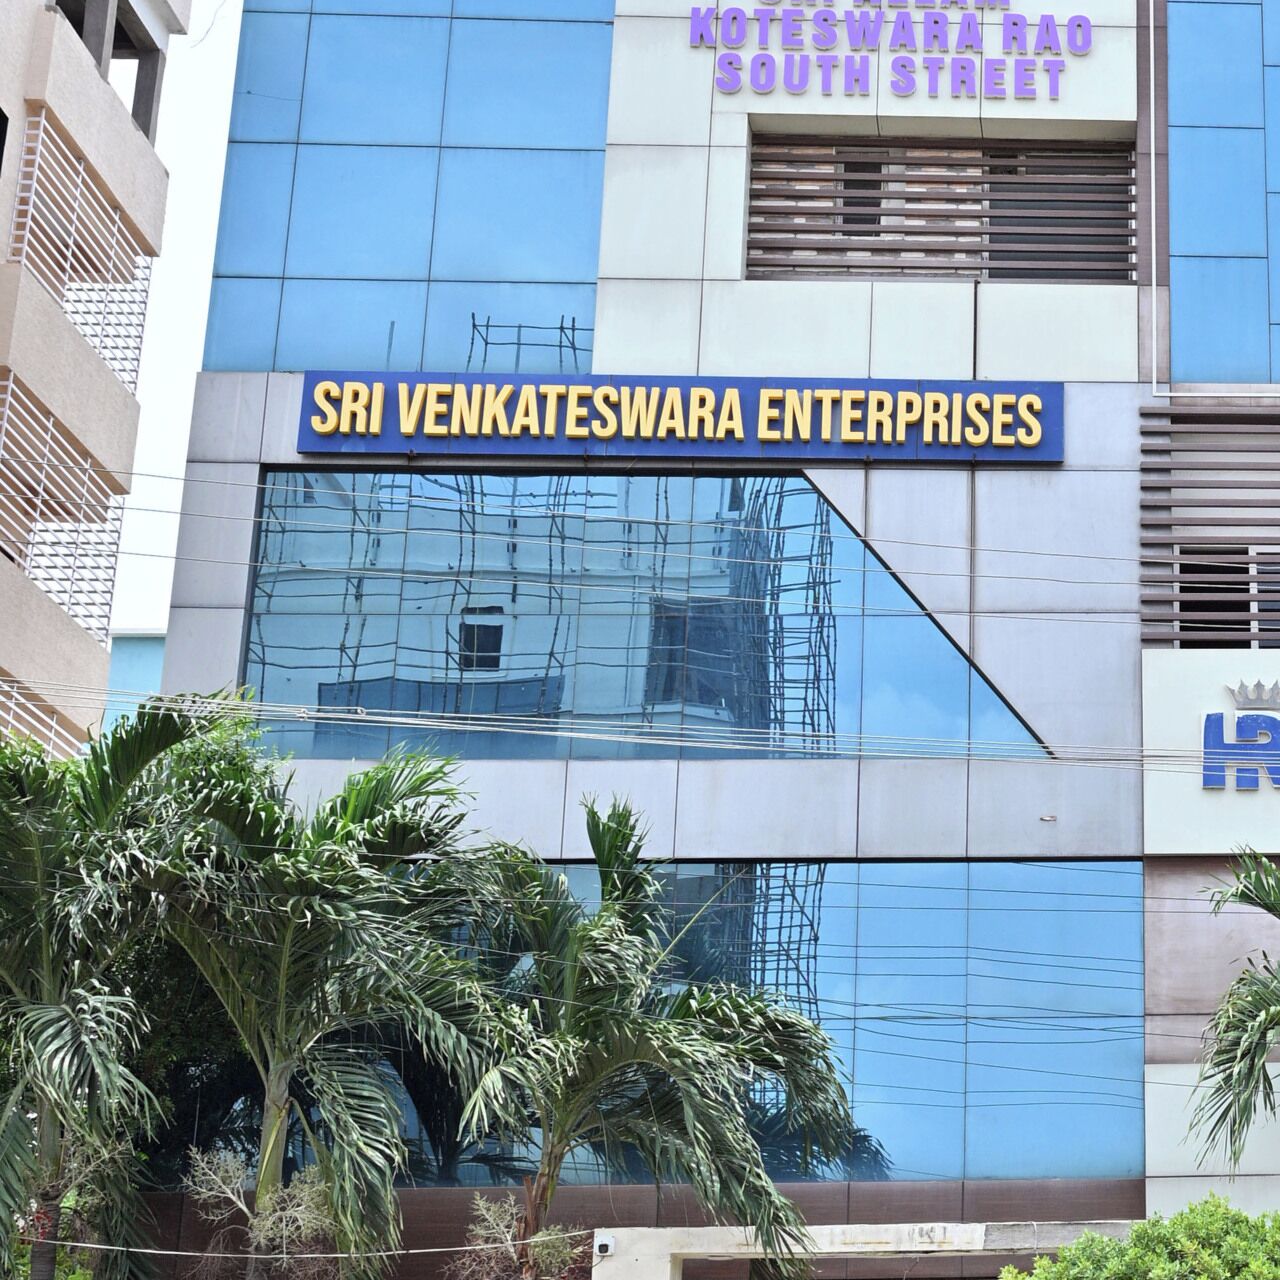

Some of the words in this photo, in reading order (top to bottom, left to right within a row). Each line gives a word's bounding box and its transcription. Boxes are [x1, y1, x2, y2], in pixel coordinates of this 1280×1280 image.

[690, 6, 984, 53] KOTESWARA
[1002, 13, 1092, 56] RAO
[715, 52, 870, 96] SOUTH
[890, 55, 1066, 100] STREET
[310, 380, 384, 436] SRI
[397, 381, 745, 442] VENKATESWARA
[757, 387, 1043, 448] ENTERPRISES
